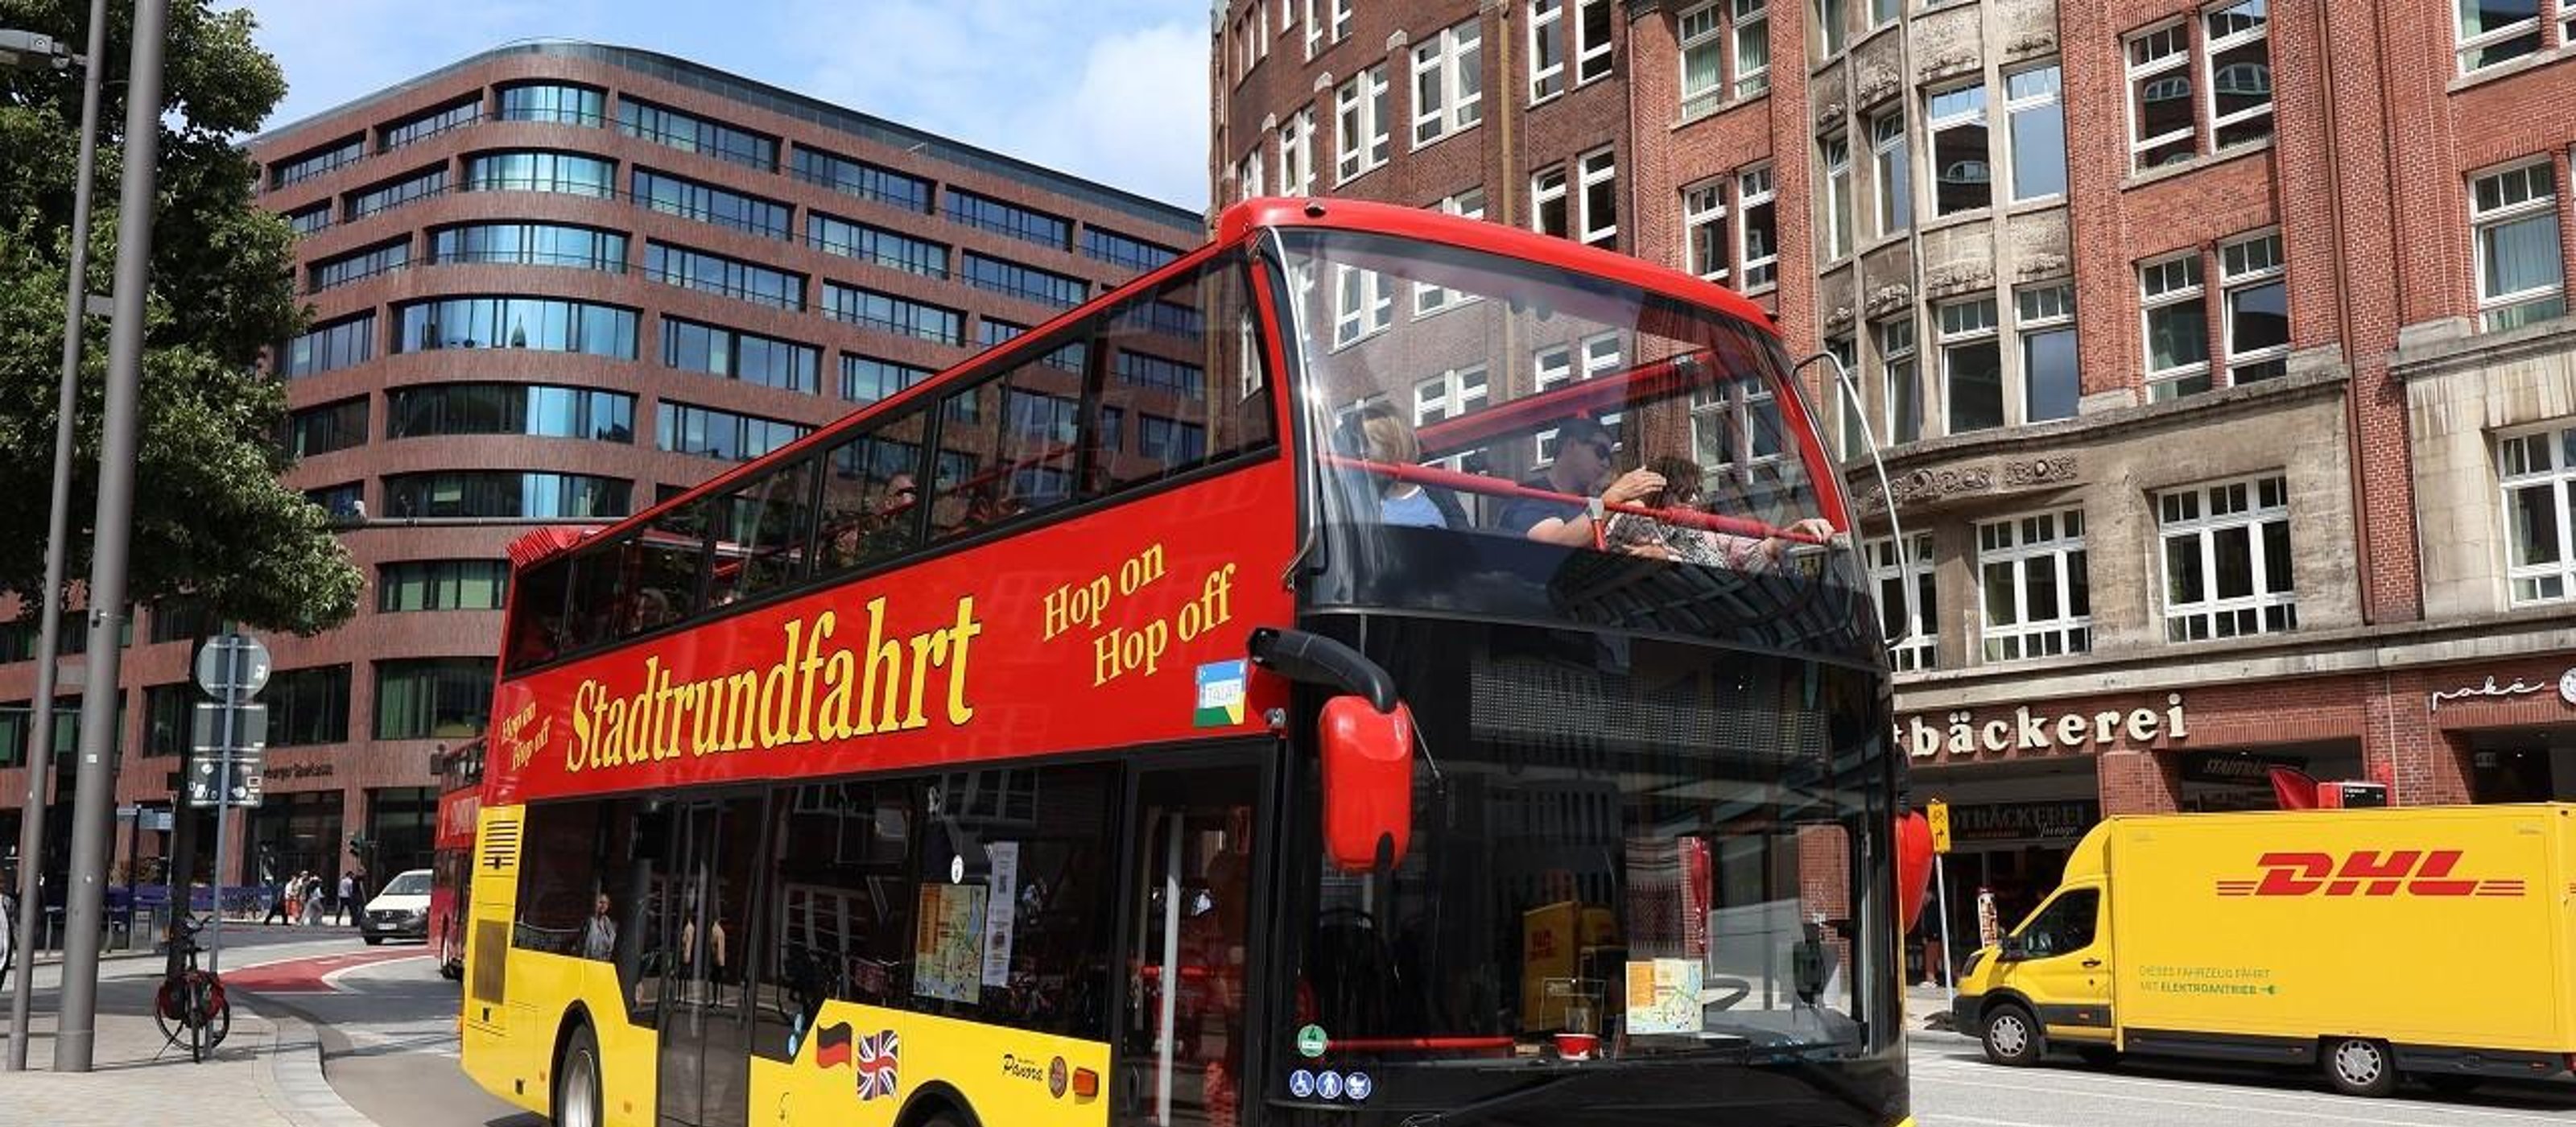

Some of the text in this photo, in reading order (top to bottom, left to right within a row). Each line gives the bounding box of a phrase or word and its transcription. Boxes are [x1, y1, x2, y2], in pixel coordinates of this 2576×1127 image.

[1042, 542, 1166, 643] Hop on
[1093, 562, 1237, 687] Hop off
[565, 595, 982, 774] Stadtrundfahrt
[2254, 850, 2480, 897] DHL
[2161, 981, 2257, 996] ELEKTROANTRIEB
[1307, 1026, 1318, 1041] 4
